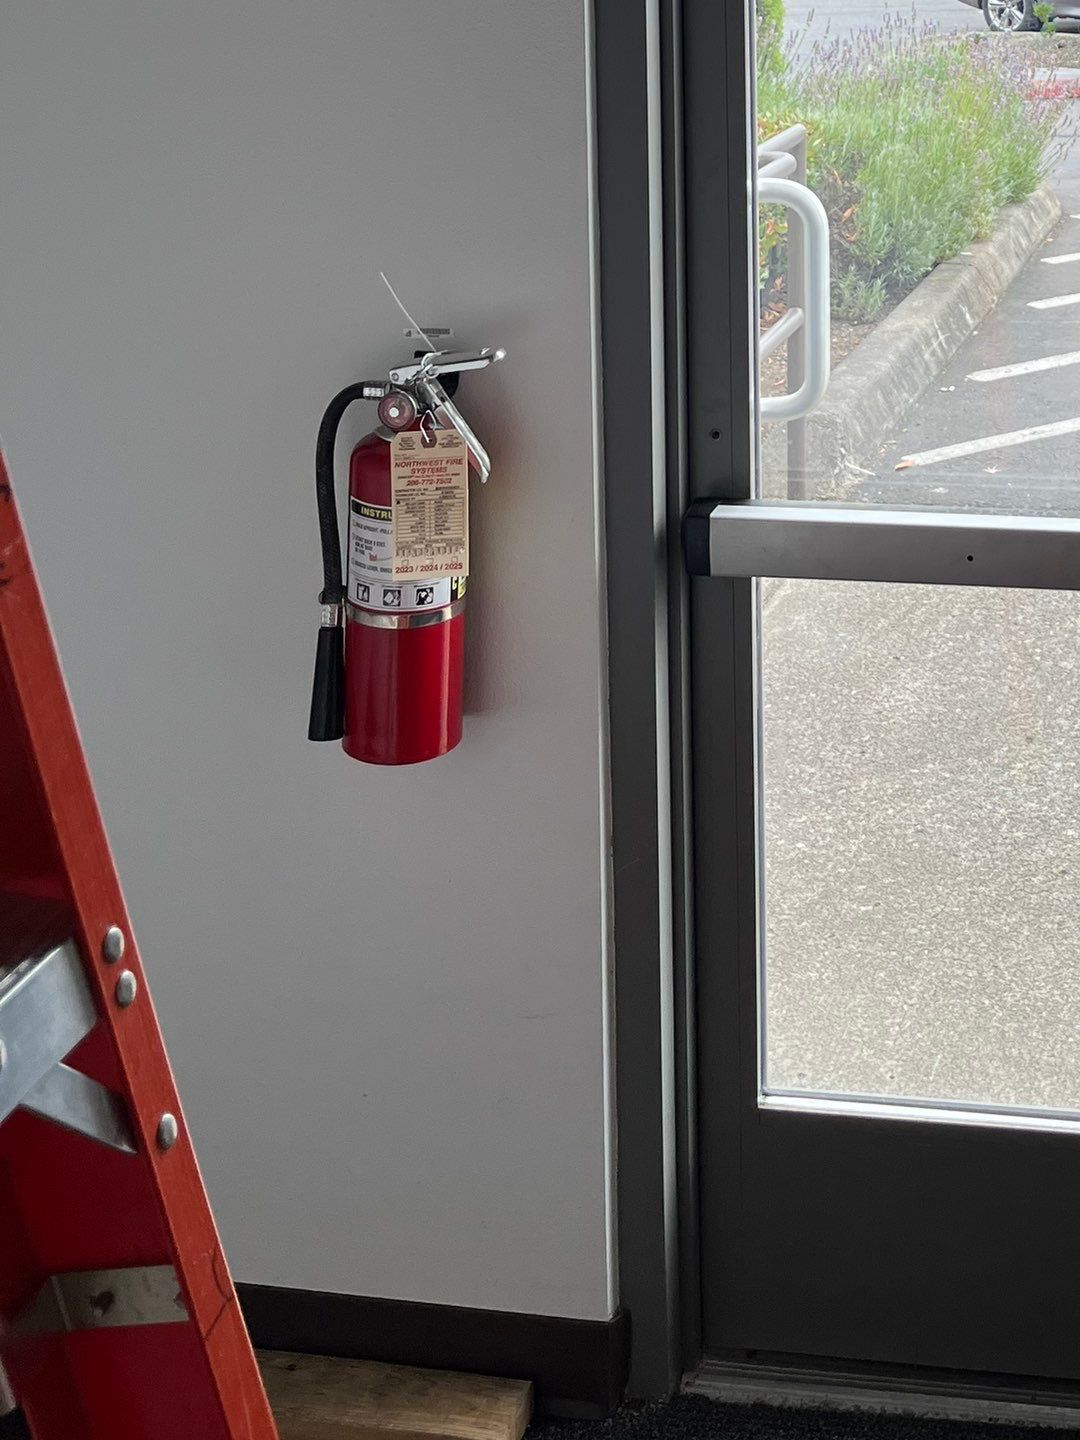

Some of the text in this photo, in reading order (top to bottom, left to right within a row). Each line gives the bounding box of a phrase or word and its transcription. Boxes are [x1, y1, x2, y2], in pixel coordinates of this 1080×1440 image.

[394, 458, 463, 468] NORTHWEST FIRE
[410, 467, 448, 475] SYSTEMS
[395, 566, 413, 574] 2023
